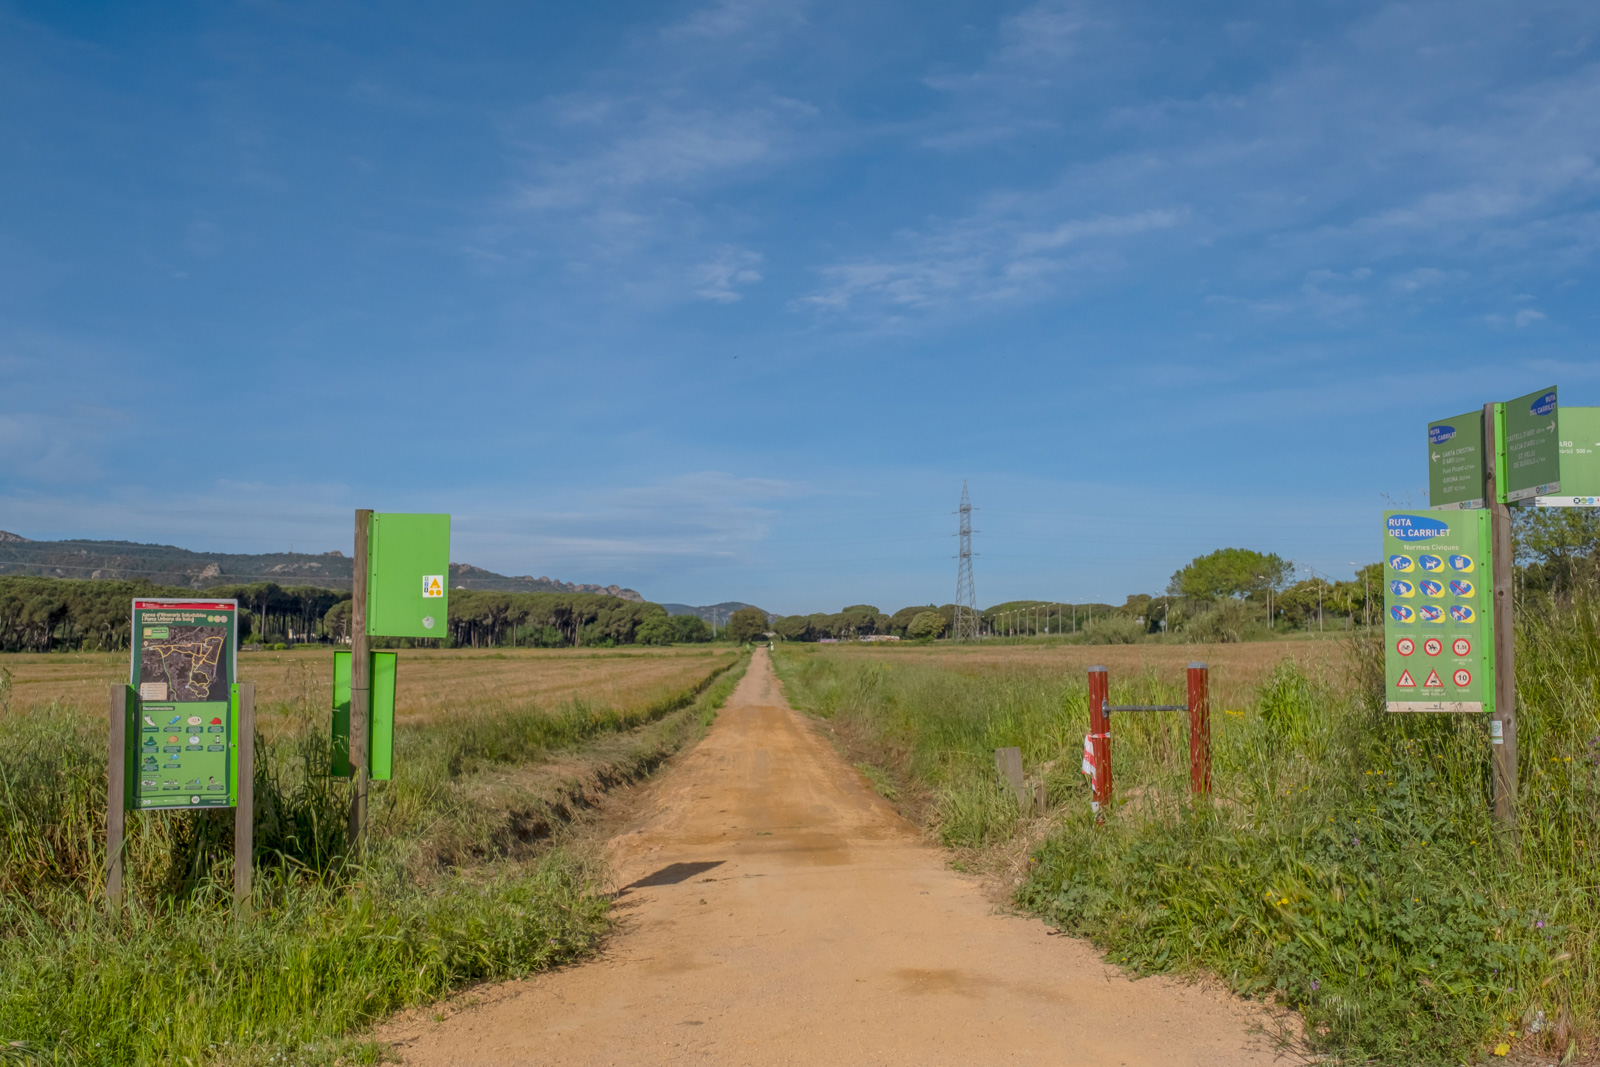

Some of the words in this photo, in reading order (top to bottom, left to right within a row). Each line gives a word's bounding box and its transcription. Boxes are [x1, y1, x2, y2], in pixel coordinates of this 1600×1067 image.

[1537, 402, 1556, 414] CARRILET
[1437, 431, 1457, 441] CARRILET
[1442, 449, 1456, 458] SANTA
[1456, 445, 1475, 456] CRISTINA
[1442, 475, 1459, 484] GIRONA
[1442, 485, 1454, 494] OLOT
[1388, 518, 1412, 527] RUTA
[1389, 528, 1407, 537] DEL
[1408, 528, 1451, 537] CARRILET
